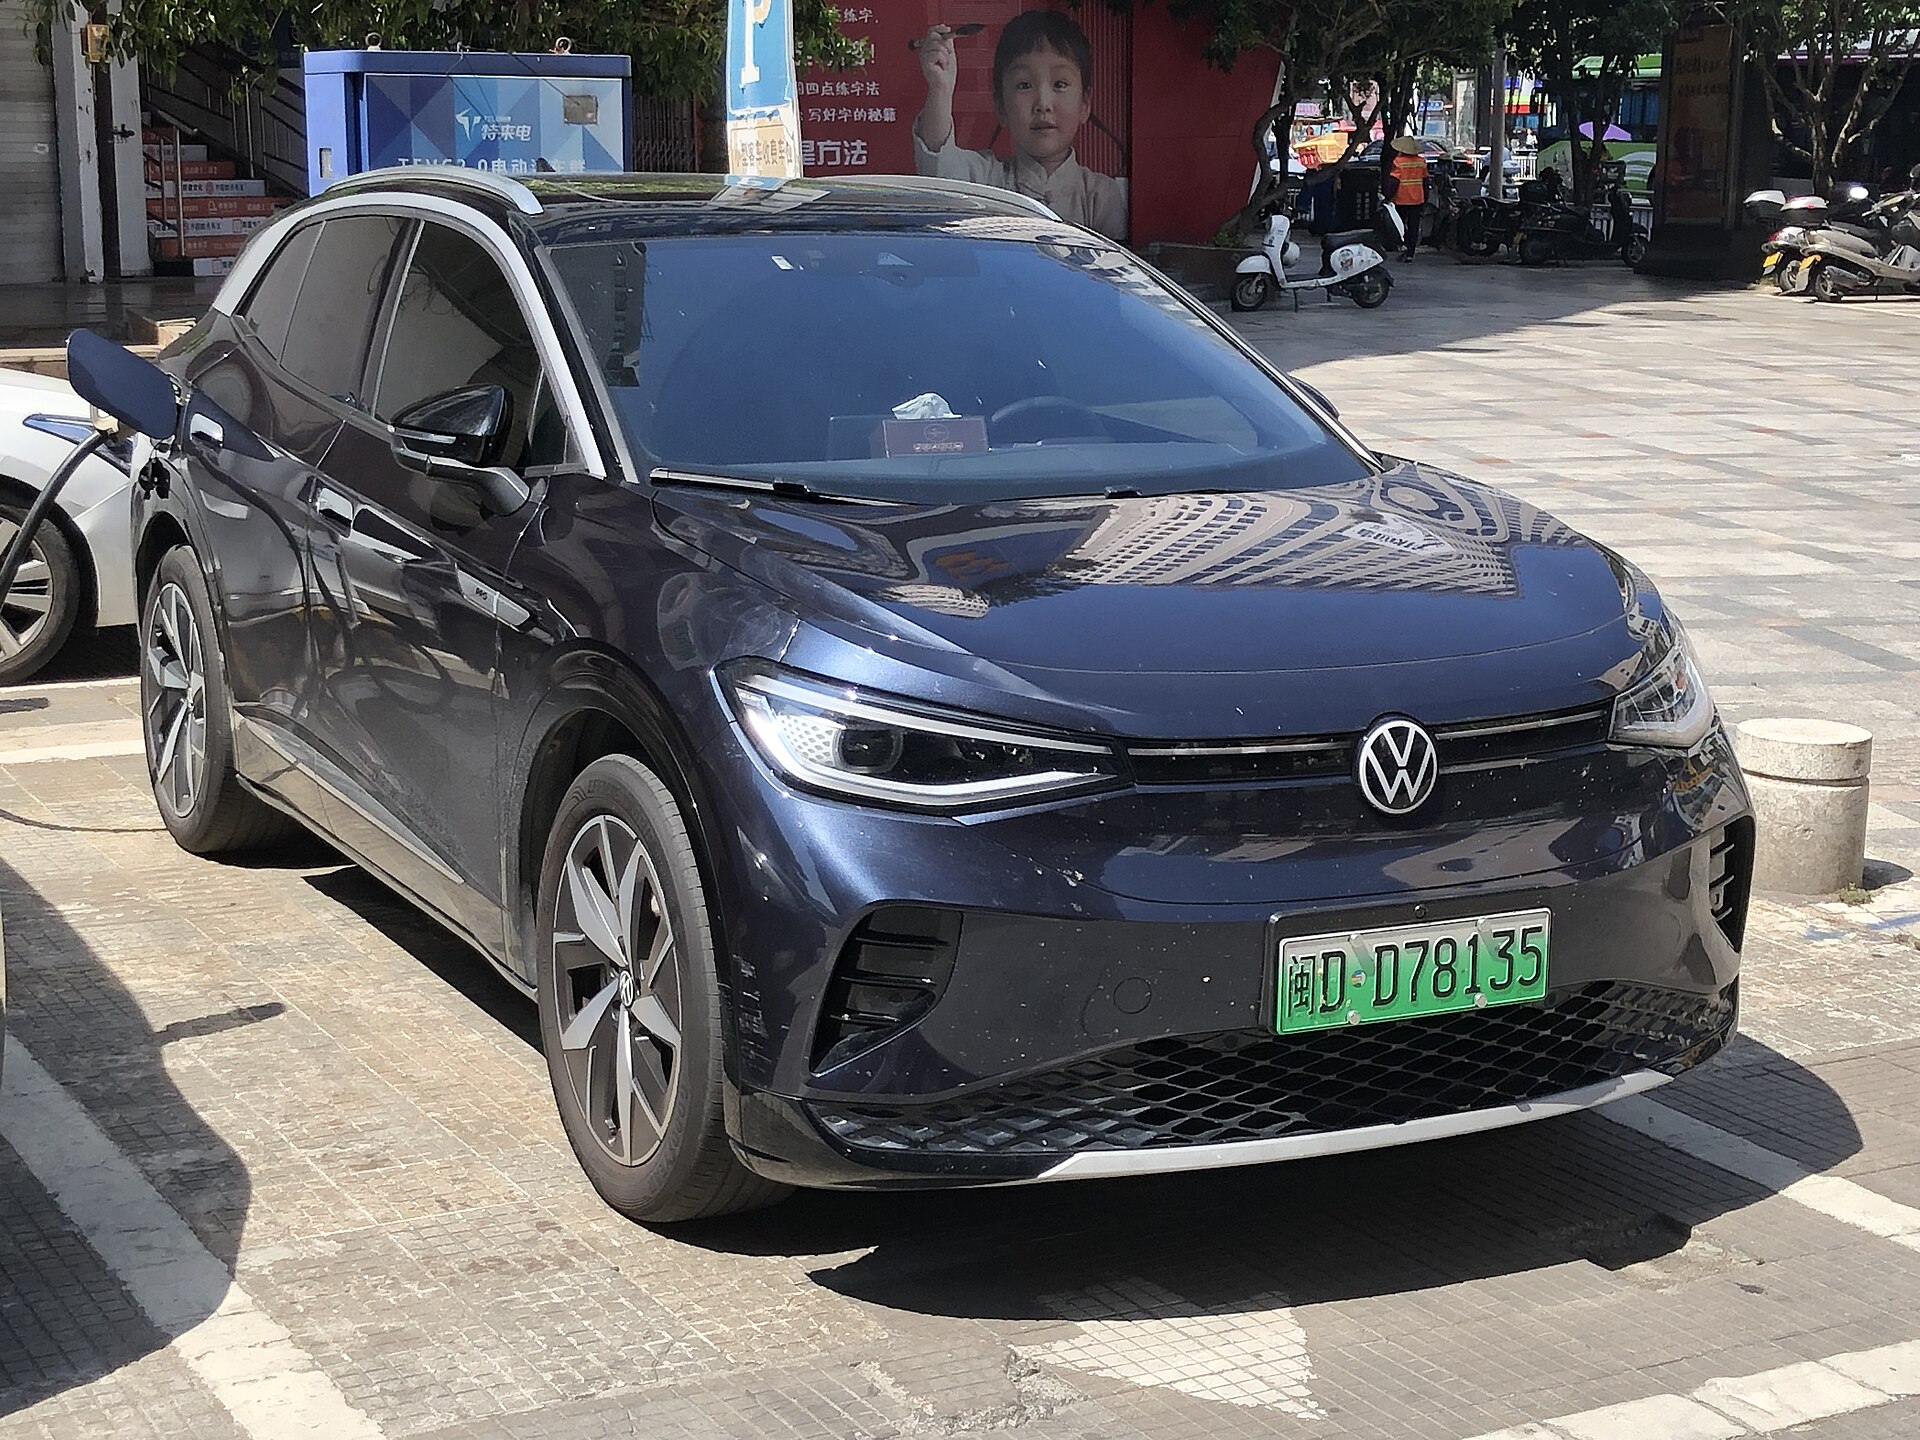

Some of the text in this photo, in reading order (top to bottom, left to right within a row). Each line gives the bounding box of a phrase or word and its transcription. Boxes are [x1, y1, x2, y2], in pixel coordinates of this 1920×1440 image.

[481, 124, 532, 141] 特来电
[1287, 926, 1543, 1018] 闽D D78135
